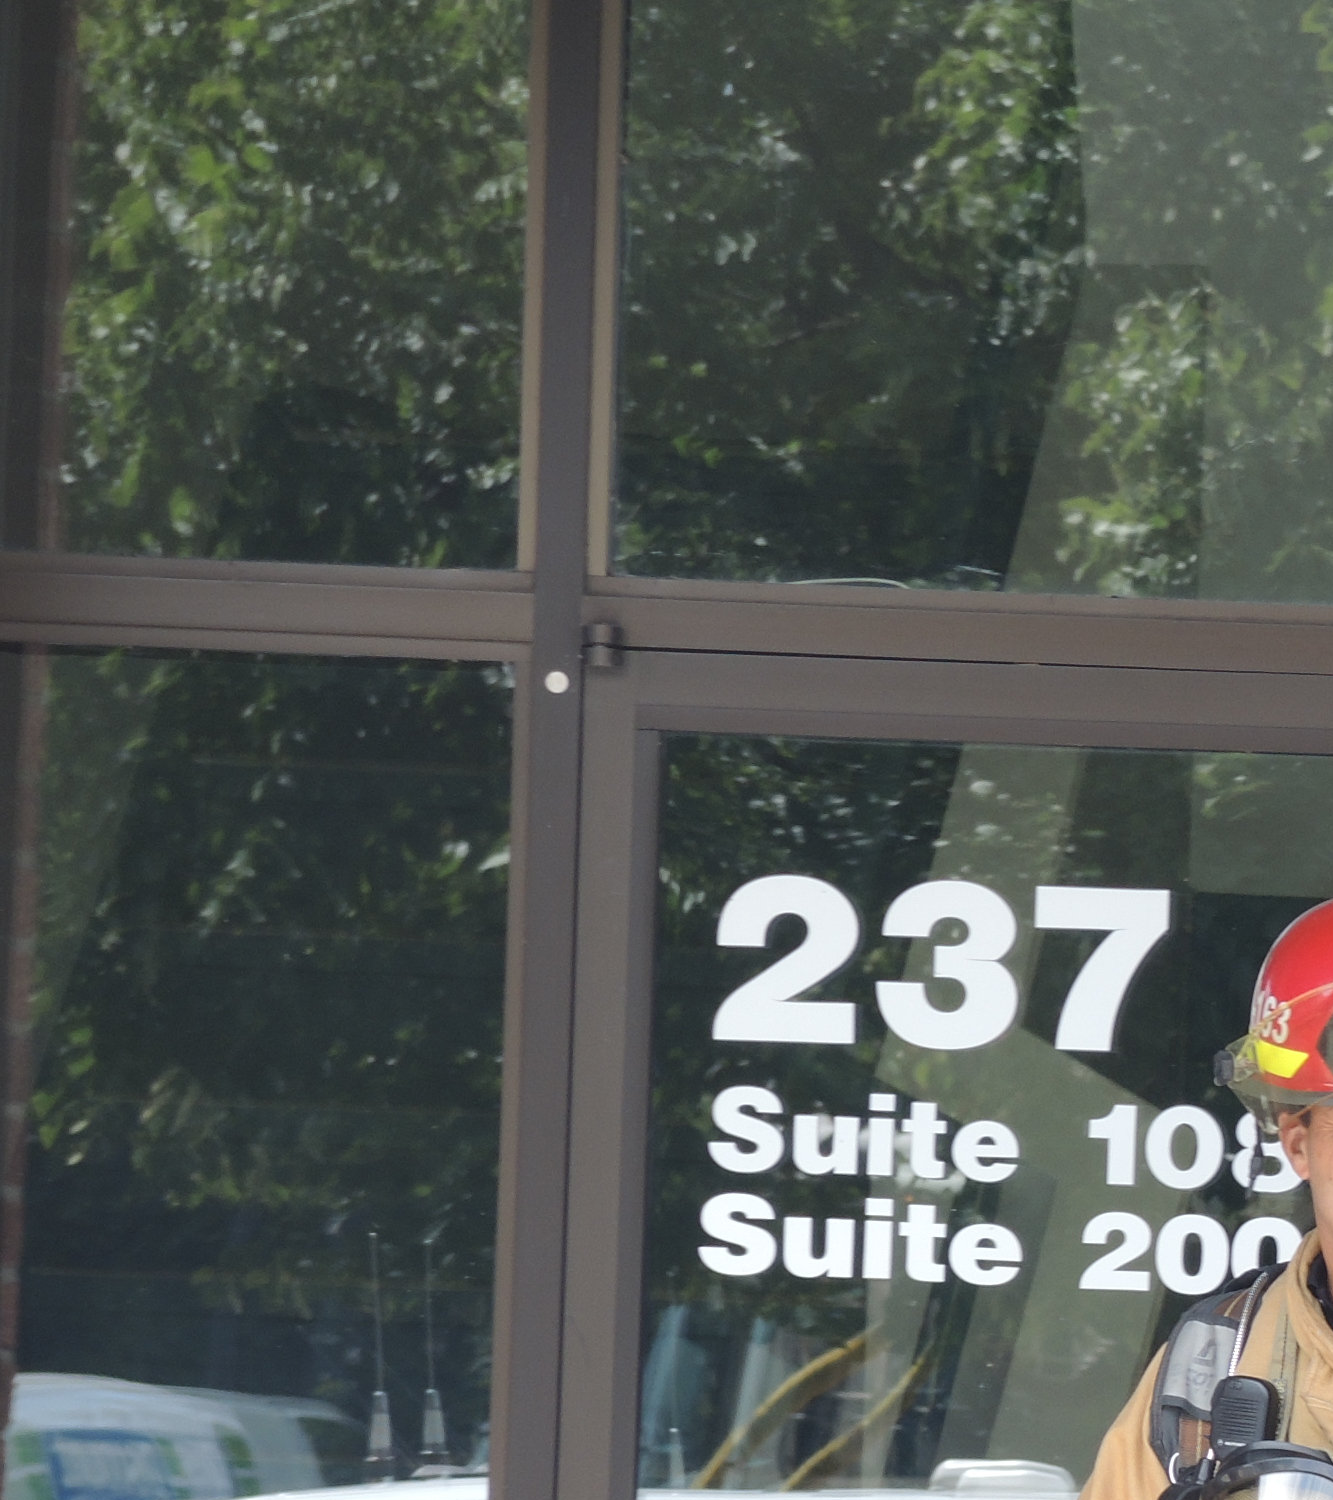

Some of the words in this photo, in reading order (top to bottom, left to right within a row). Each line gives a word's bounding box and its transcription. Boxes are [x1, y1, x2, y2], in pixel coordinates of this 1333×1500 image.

[713, 875, 1170, 1052] 237
[707, 1086, 1020, 1183] Suite
[1087, 1104, 1308, 1194] 108
[698, 1192, 1023, 1285] Suite
[1079, 1211, 1301, 1295] 200
